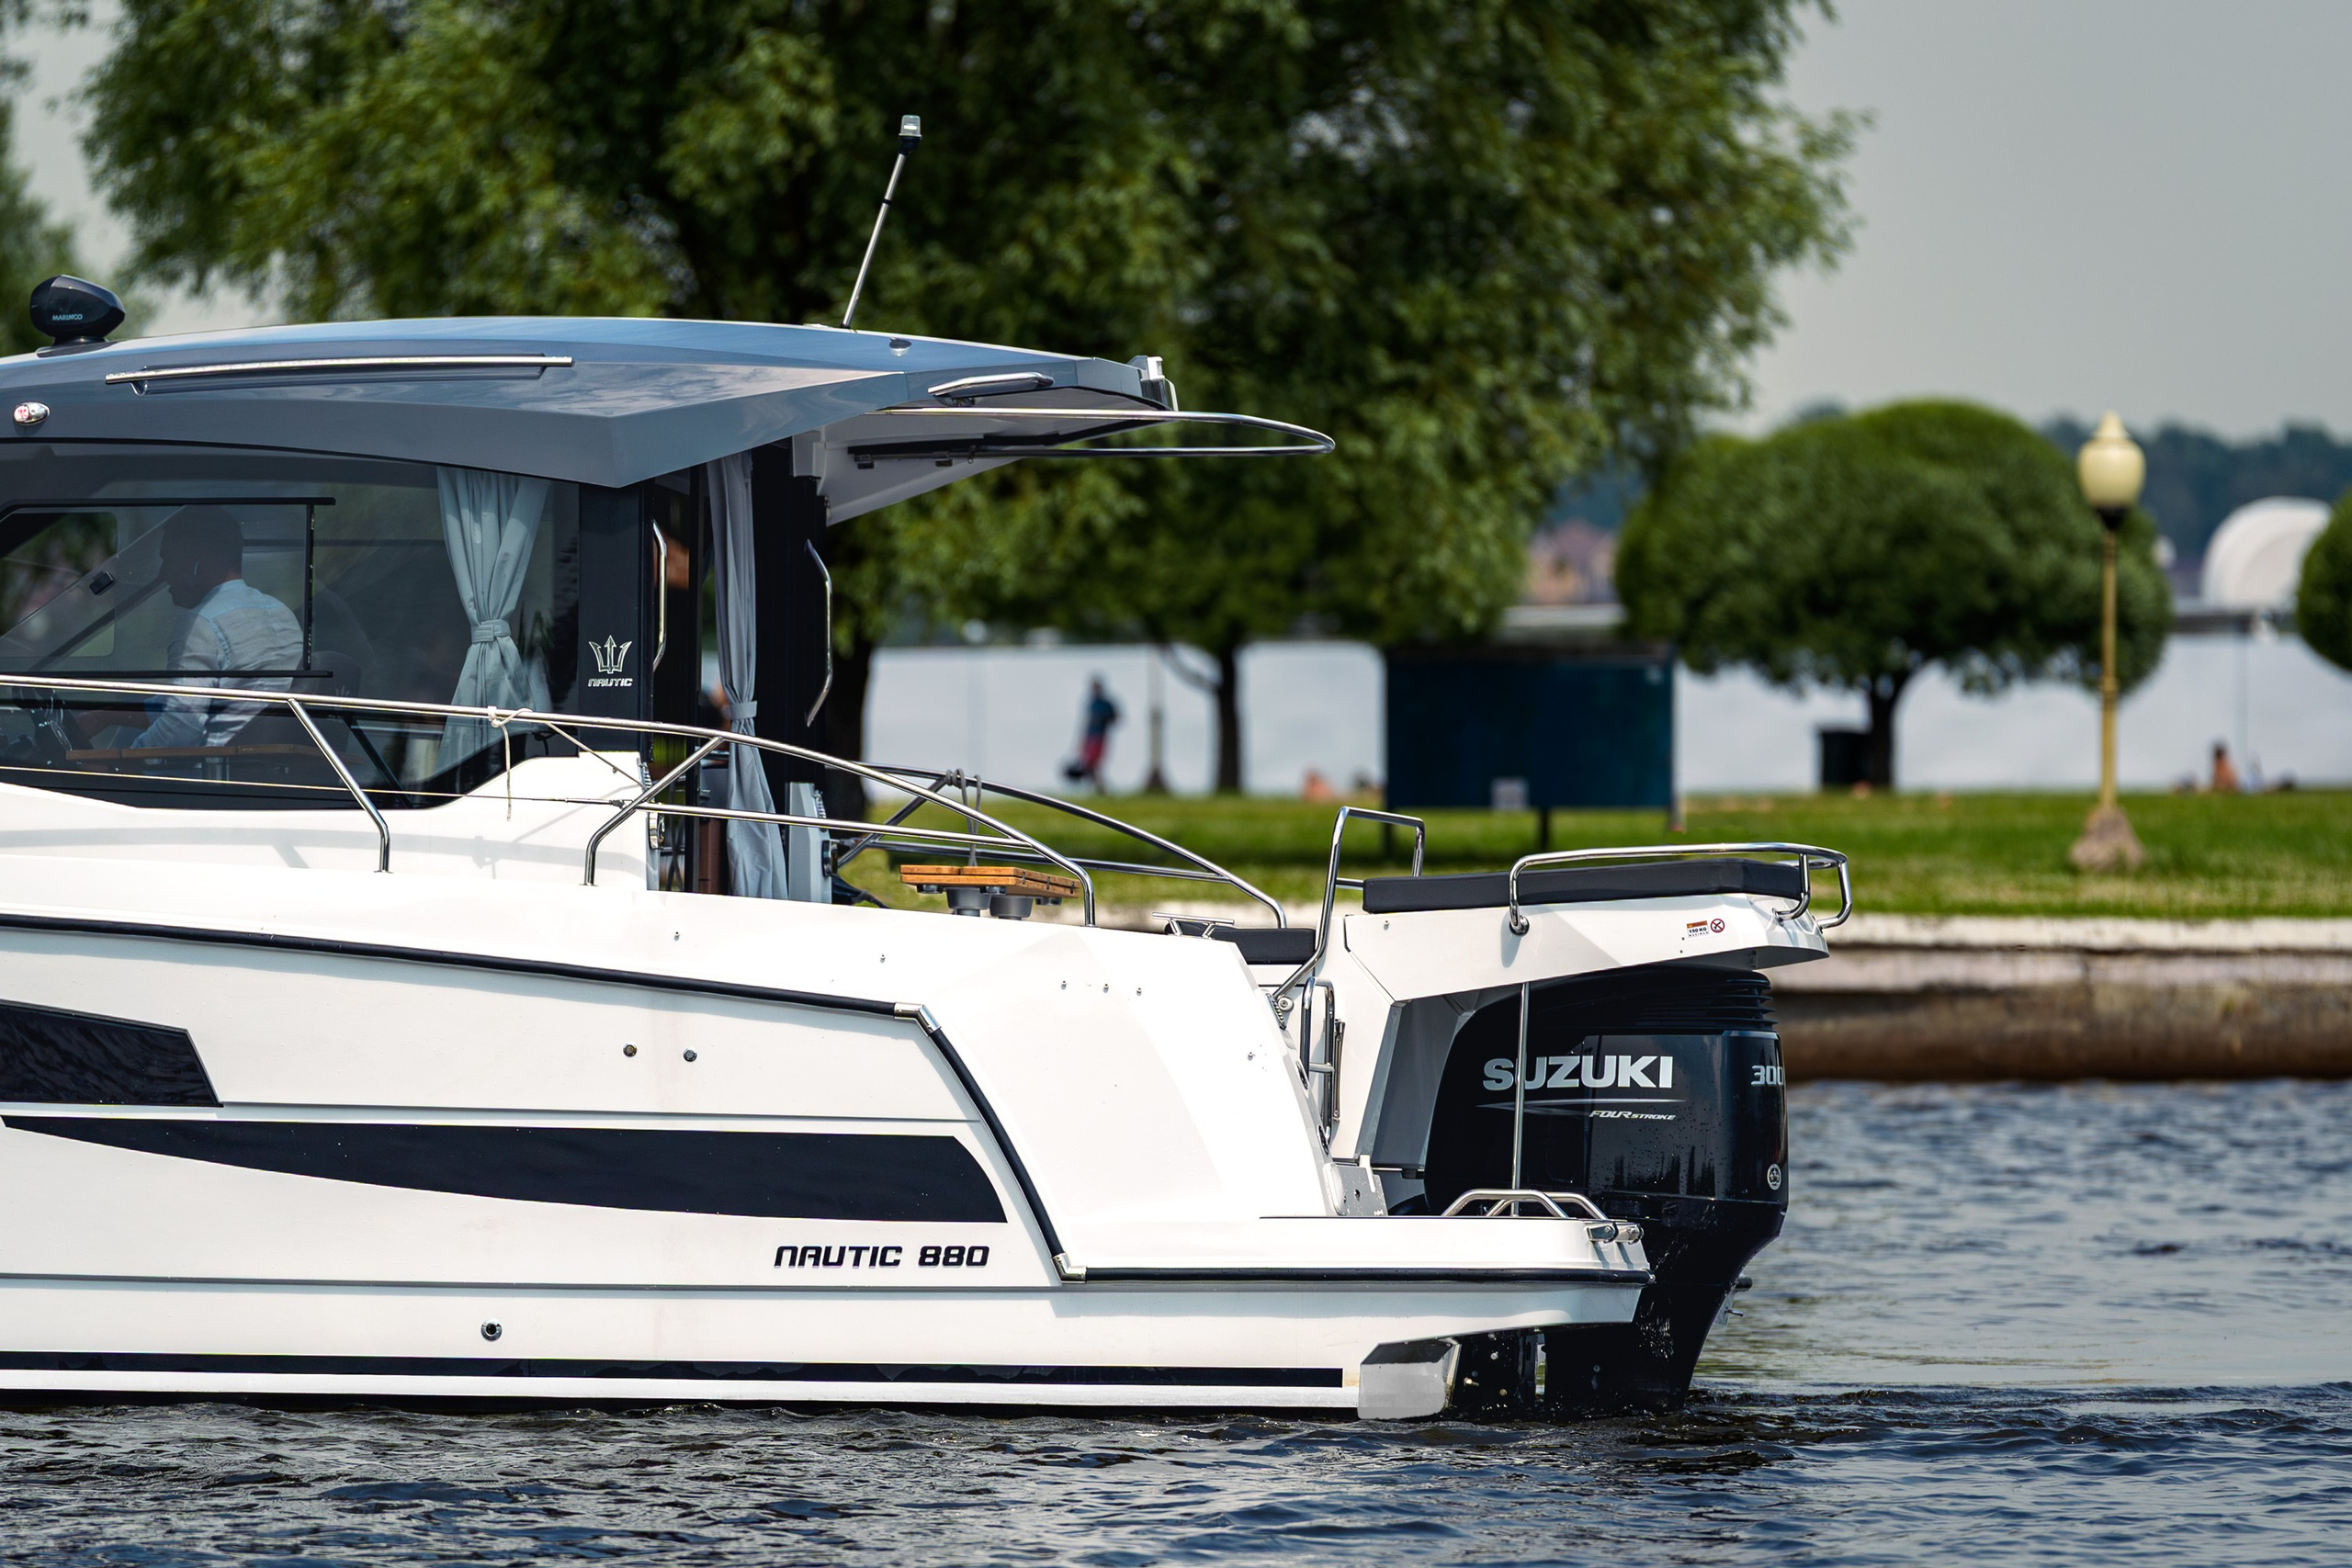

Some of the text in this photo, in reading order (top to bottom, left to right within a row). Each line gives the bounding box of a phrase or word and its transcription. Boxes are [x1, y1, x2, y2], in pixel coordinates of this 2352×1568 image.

[587, 678, 633, 687] NAUTIC
[1483, 1055, 1673, 1090] SUZUKI
[1750, 1065, 1784, 1085] 300
[774, 1246, 989, 1268] NAUTIC 880
